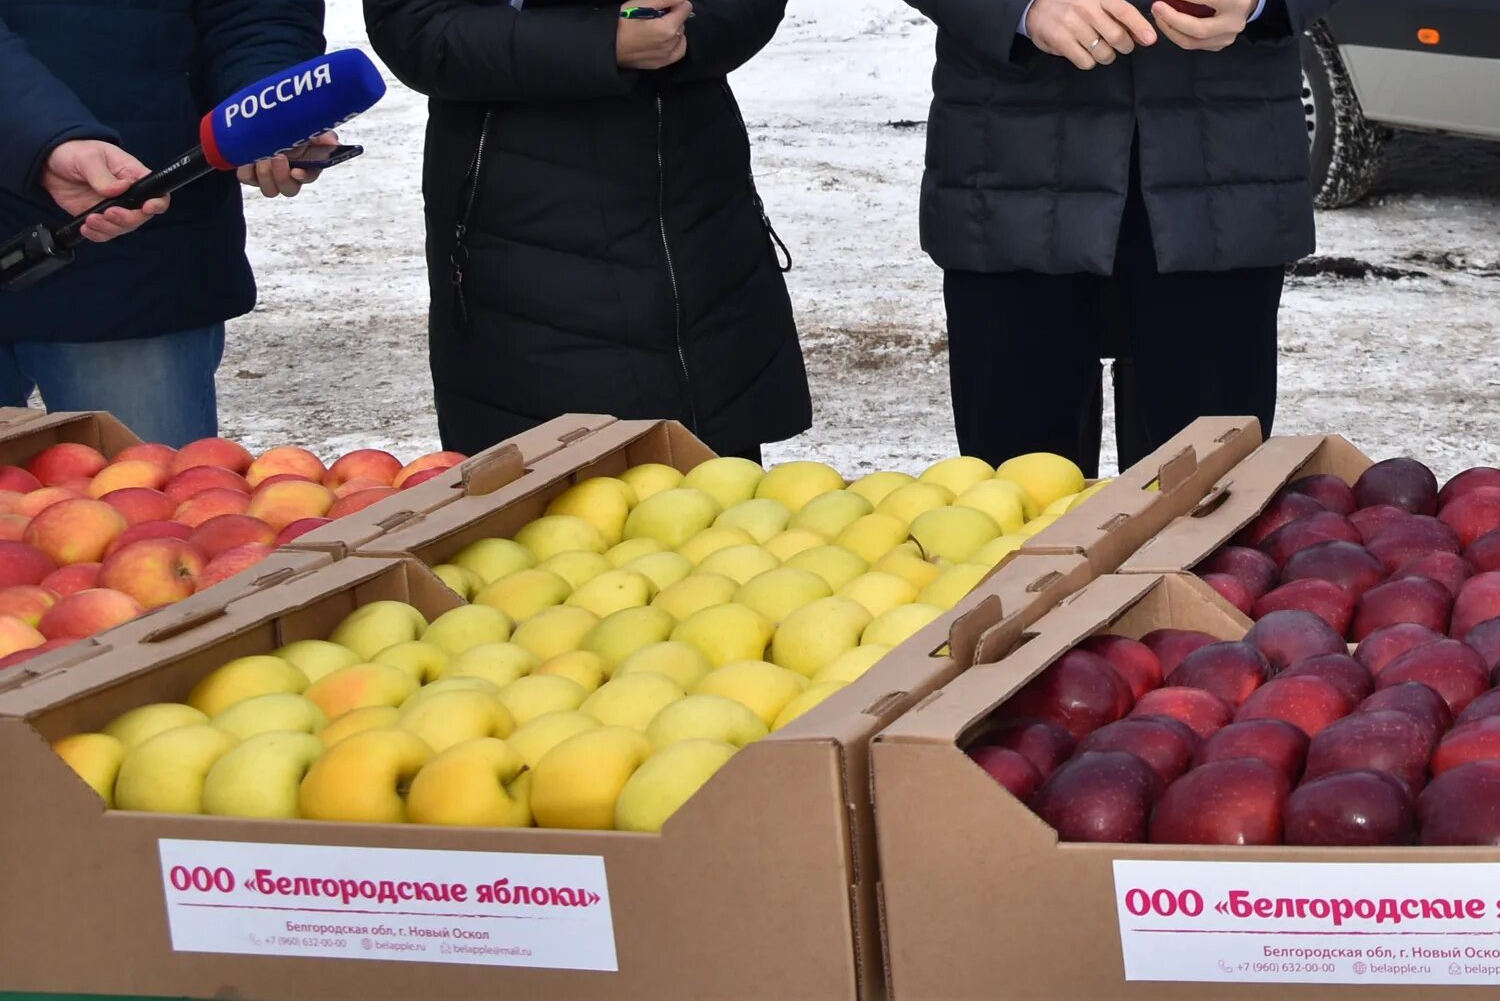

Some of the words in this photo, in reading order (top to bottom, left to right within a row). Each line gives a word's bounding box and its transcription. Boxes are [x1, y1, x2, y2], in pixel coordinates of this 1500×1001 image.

[225, 63, 332, 128] РОССИЯ
[170, 865, 236, 893] ООО
[244, 868, 468, 904] «Белгородские
[475, 877, 601, 907] яблоки»
[1125, 888, 1204, 917] ООО
[1214, 890, 1486, 926] «Белгородские
[286, 921, 369, 935] Белгородская
[371, 925, 397, 937] обл,
[399, 927, 407, 936] г.
[409, 925, 450, 938] Новый
[452, 927, 490, 940] Оскол
[302, 937, 348, 948] 632-00-00
[1263, 945, 1363, 960] Белгородская
[1366, 945, 1397, 959] обл,
[1399, 948, 1409, 959] г.
[1412, 946, 1461, 959] Новый
[1236, 962, 1250, 973] +7
[1252, 961, 1280, 974] (960)
[1281, 962, 1336, 973] 632-00-00
[1369, 962, 1432, 975] belapple.ru
